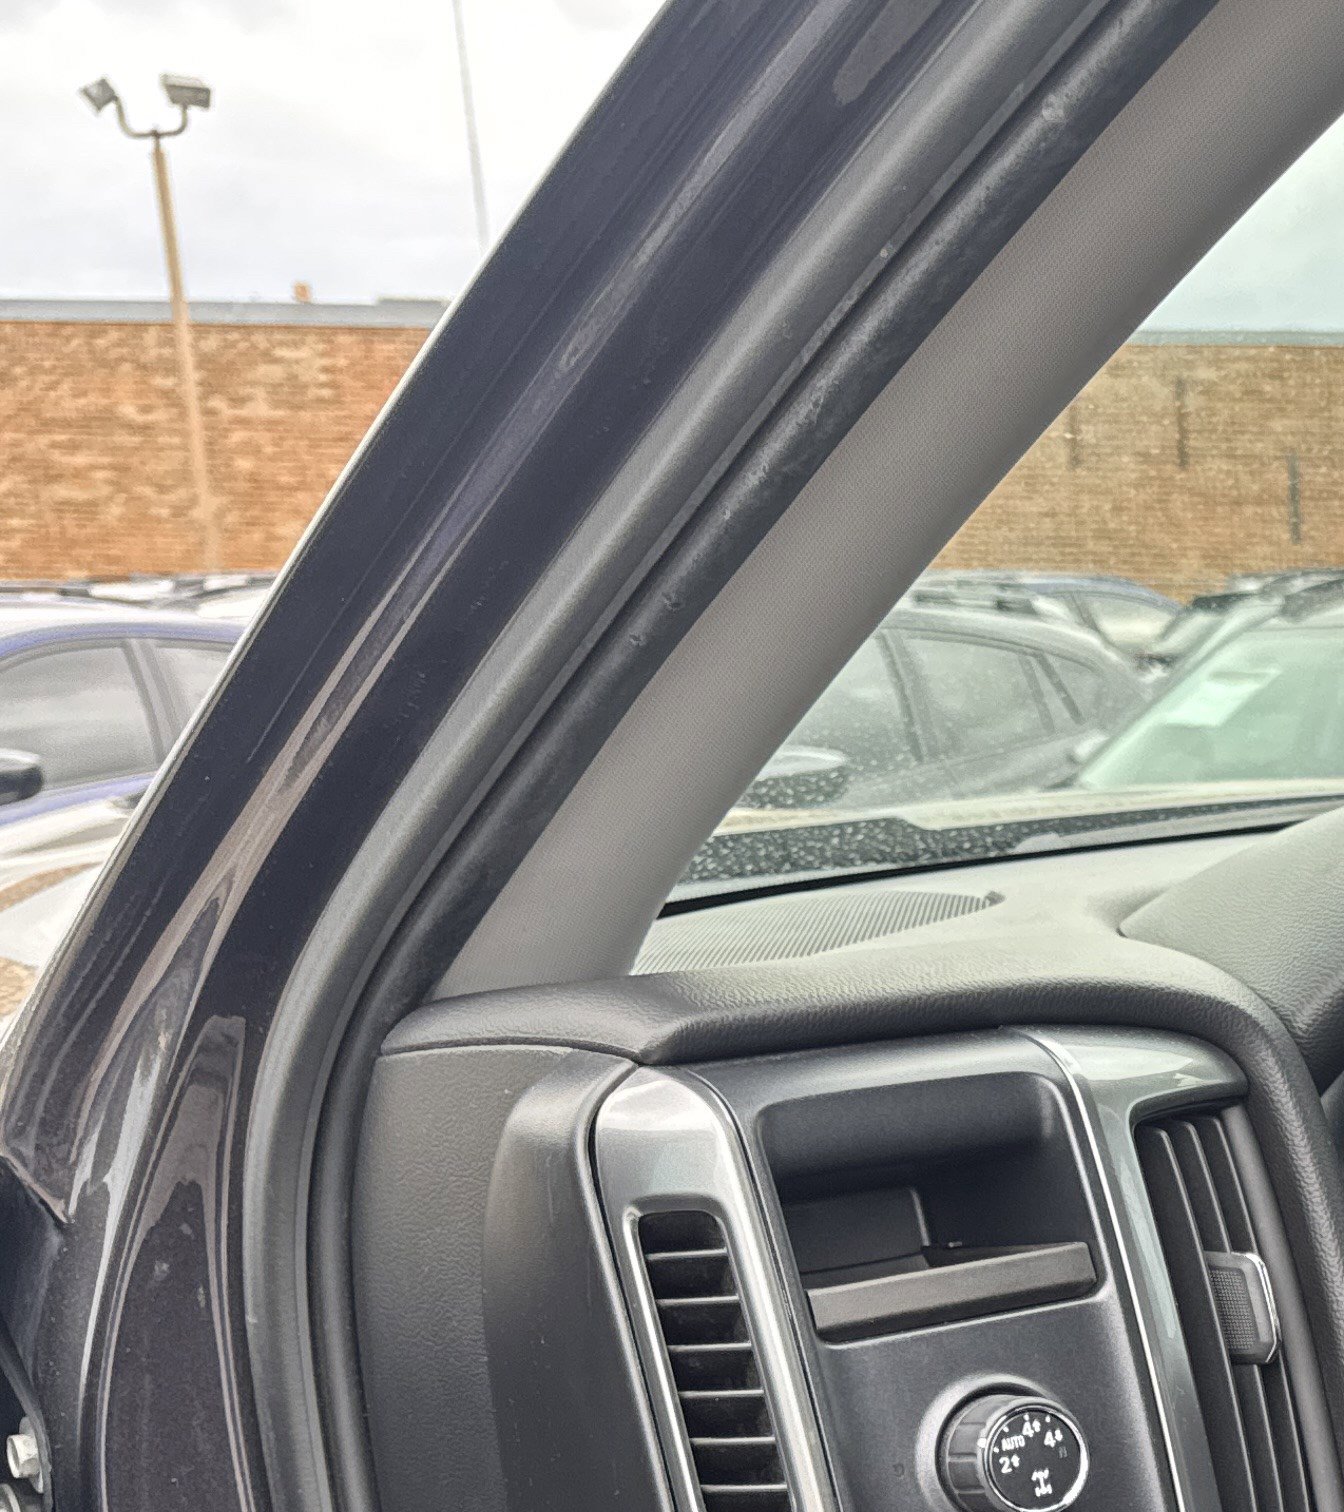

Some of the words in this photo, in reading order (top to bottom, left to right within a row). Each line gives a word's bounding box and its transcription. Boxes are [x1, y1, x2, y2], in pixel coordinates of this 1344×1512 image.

[1022, 1421, 1035, 1438] 4
[1001, 1435, 1026, 1452] AUTO
[1043, 1430, 1057, 1448] 4
[999, 1456, 1013, 1474] 2
